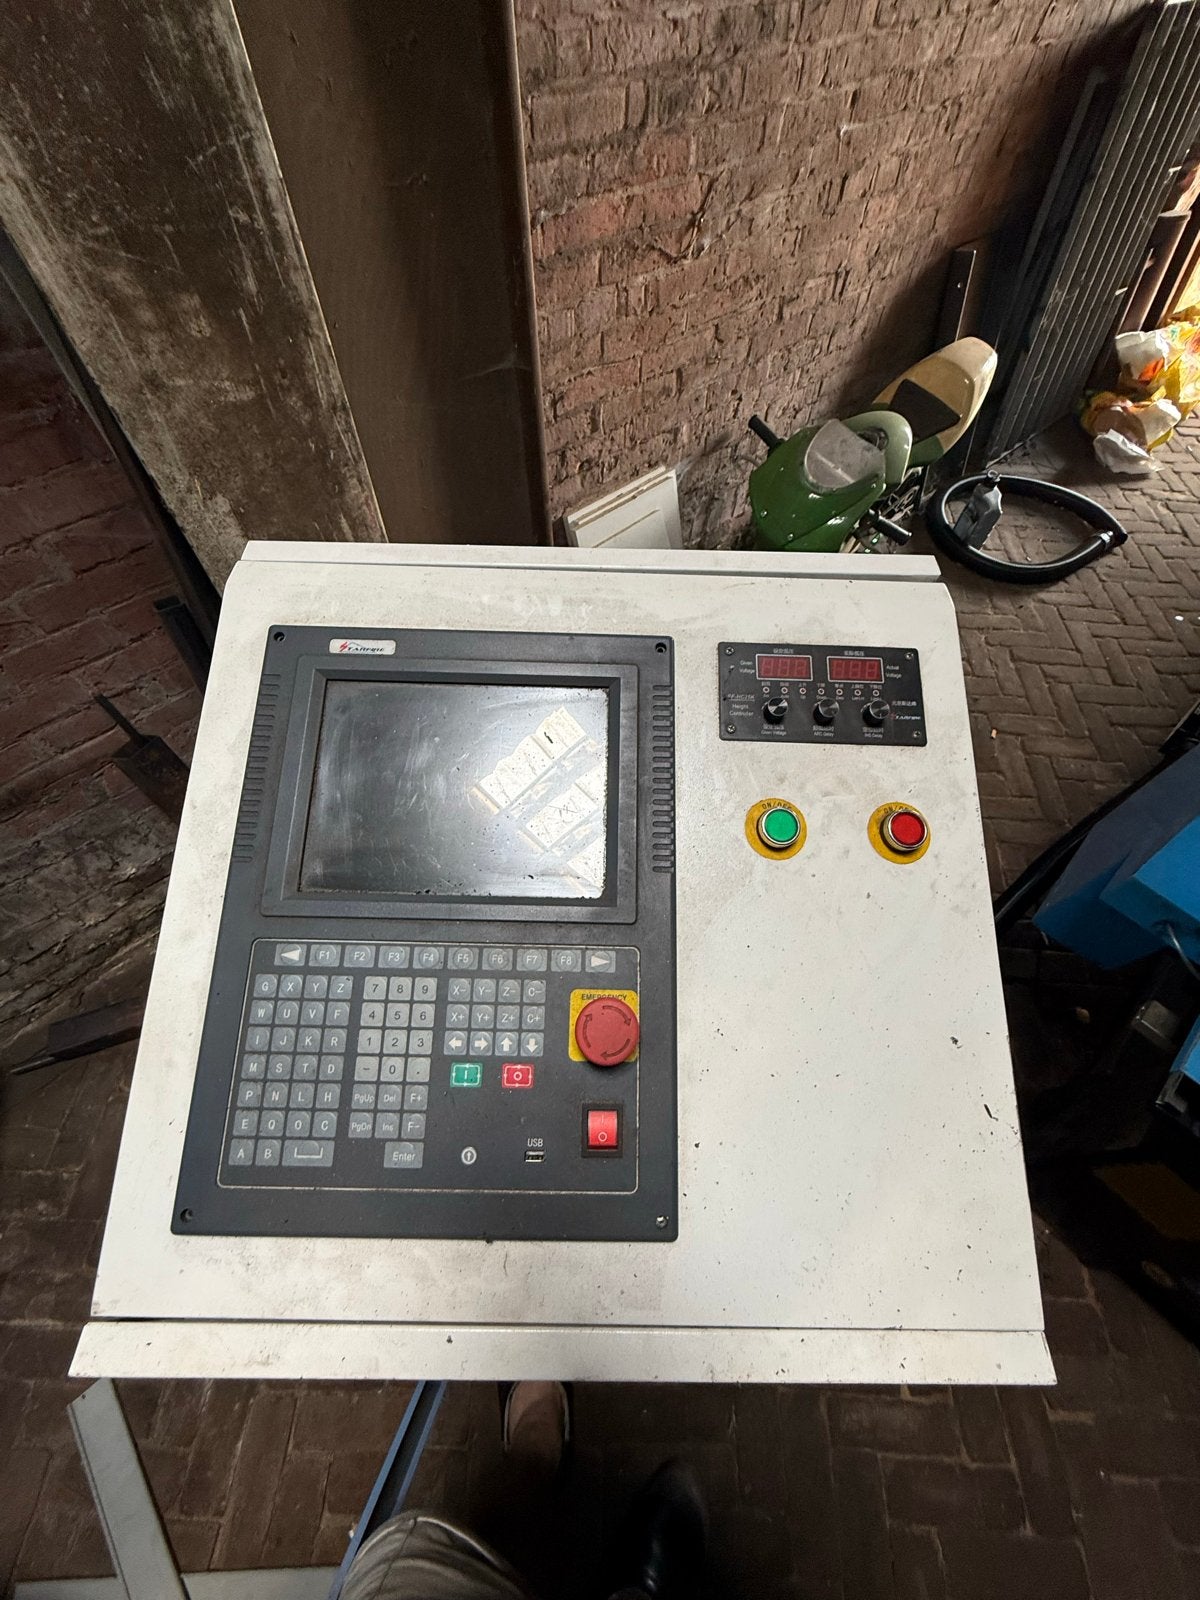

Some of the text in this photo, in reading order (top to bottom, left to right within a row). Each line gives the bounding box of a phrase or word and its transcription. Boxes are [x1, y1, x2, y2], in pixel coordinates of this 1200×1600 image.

[319, 950, 572, 965] F1 F2 F3 F4 F5 F6 F7 F8
[261, 981, 344, 993] G X Y Z
[372, 984, 429, 994] 7 8 9
[453, 985, 466, 995] X-
[479, 986, 492, 996] Y-
[503, 987, 516, 996] Z-
[257, 1008, 341, 1019] W U V F
[369, 1010, 426, 1021] 4 5 6
[451, 1012, 540, 1023] X+ Y+ Z+ C+
[255, 1035, 338, 1046] I J K R
[367, 1037, 424, 1047] 1 2 3
[249, 1062, 335, 1074] M S T D
[389, 1065, 396, 1074] 0
[245, 1090, 332, 1102] P N L H
[354, 1093, 422, 1103] PgUp Del F+
[241, 1119, 249, 1129] E
[294, 1120, 302, 1130] O
[321, 1120, 329, 1131] C
[351, 1122, 420, 1132] PgDn Ins F-
[527, 1138, 544, 1147] USB
[237, 1148, 272, 1159] A B
[392, 1151, 416, 1161] Enter
